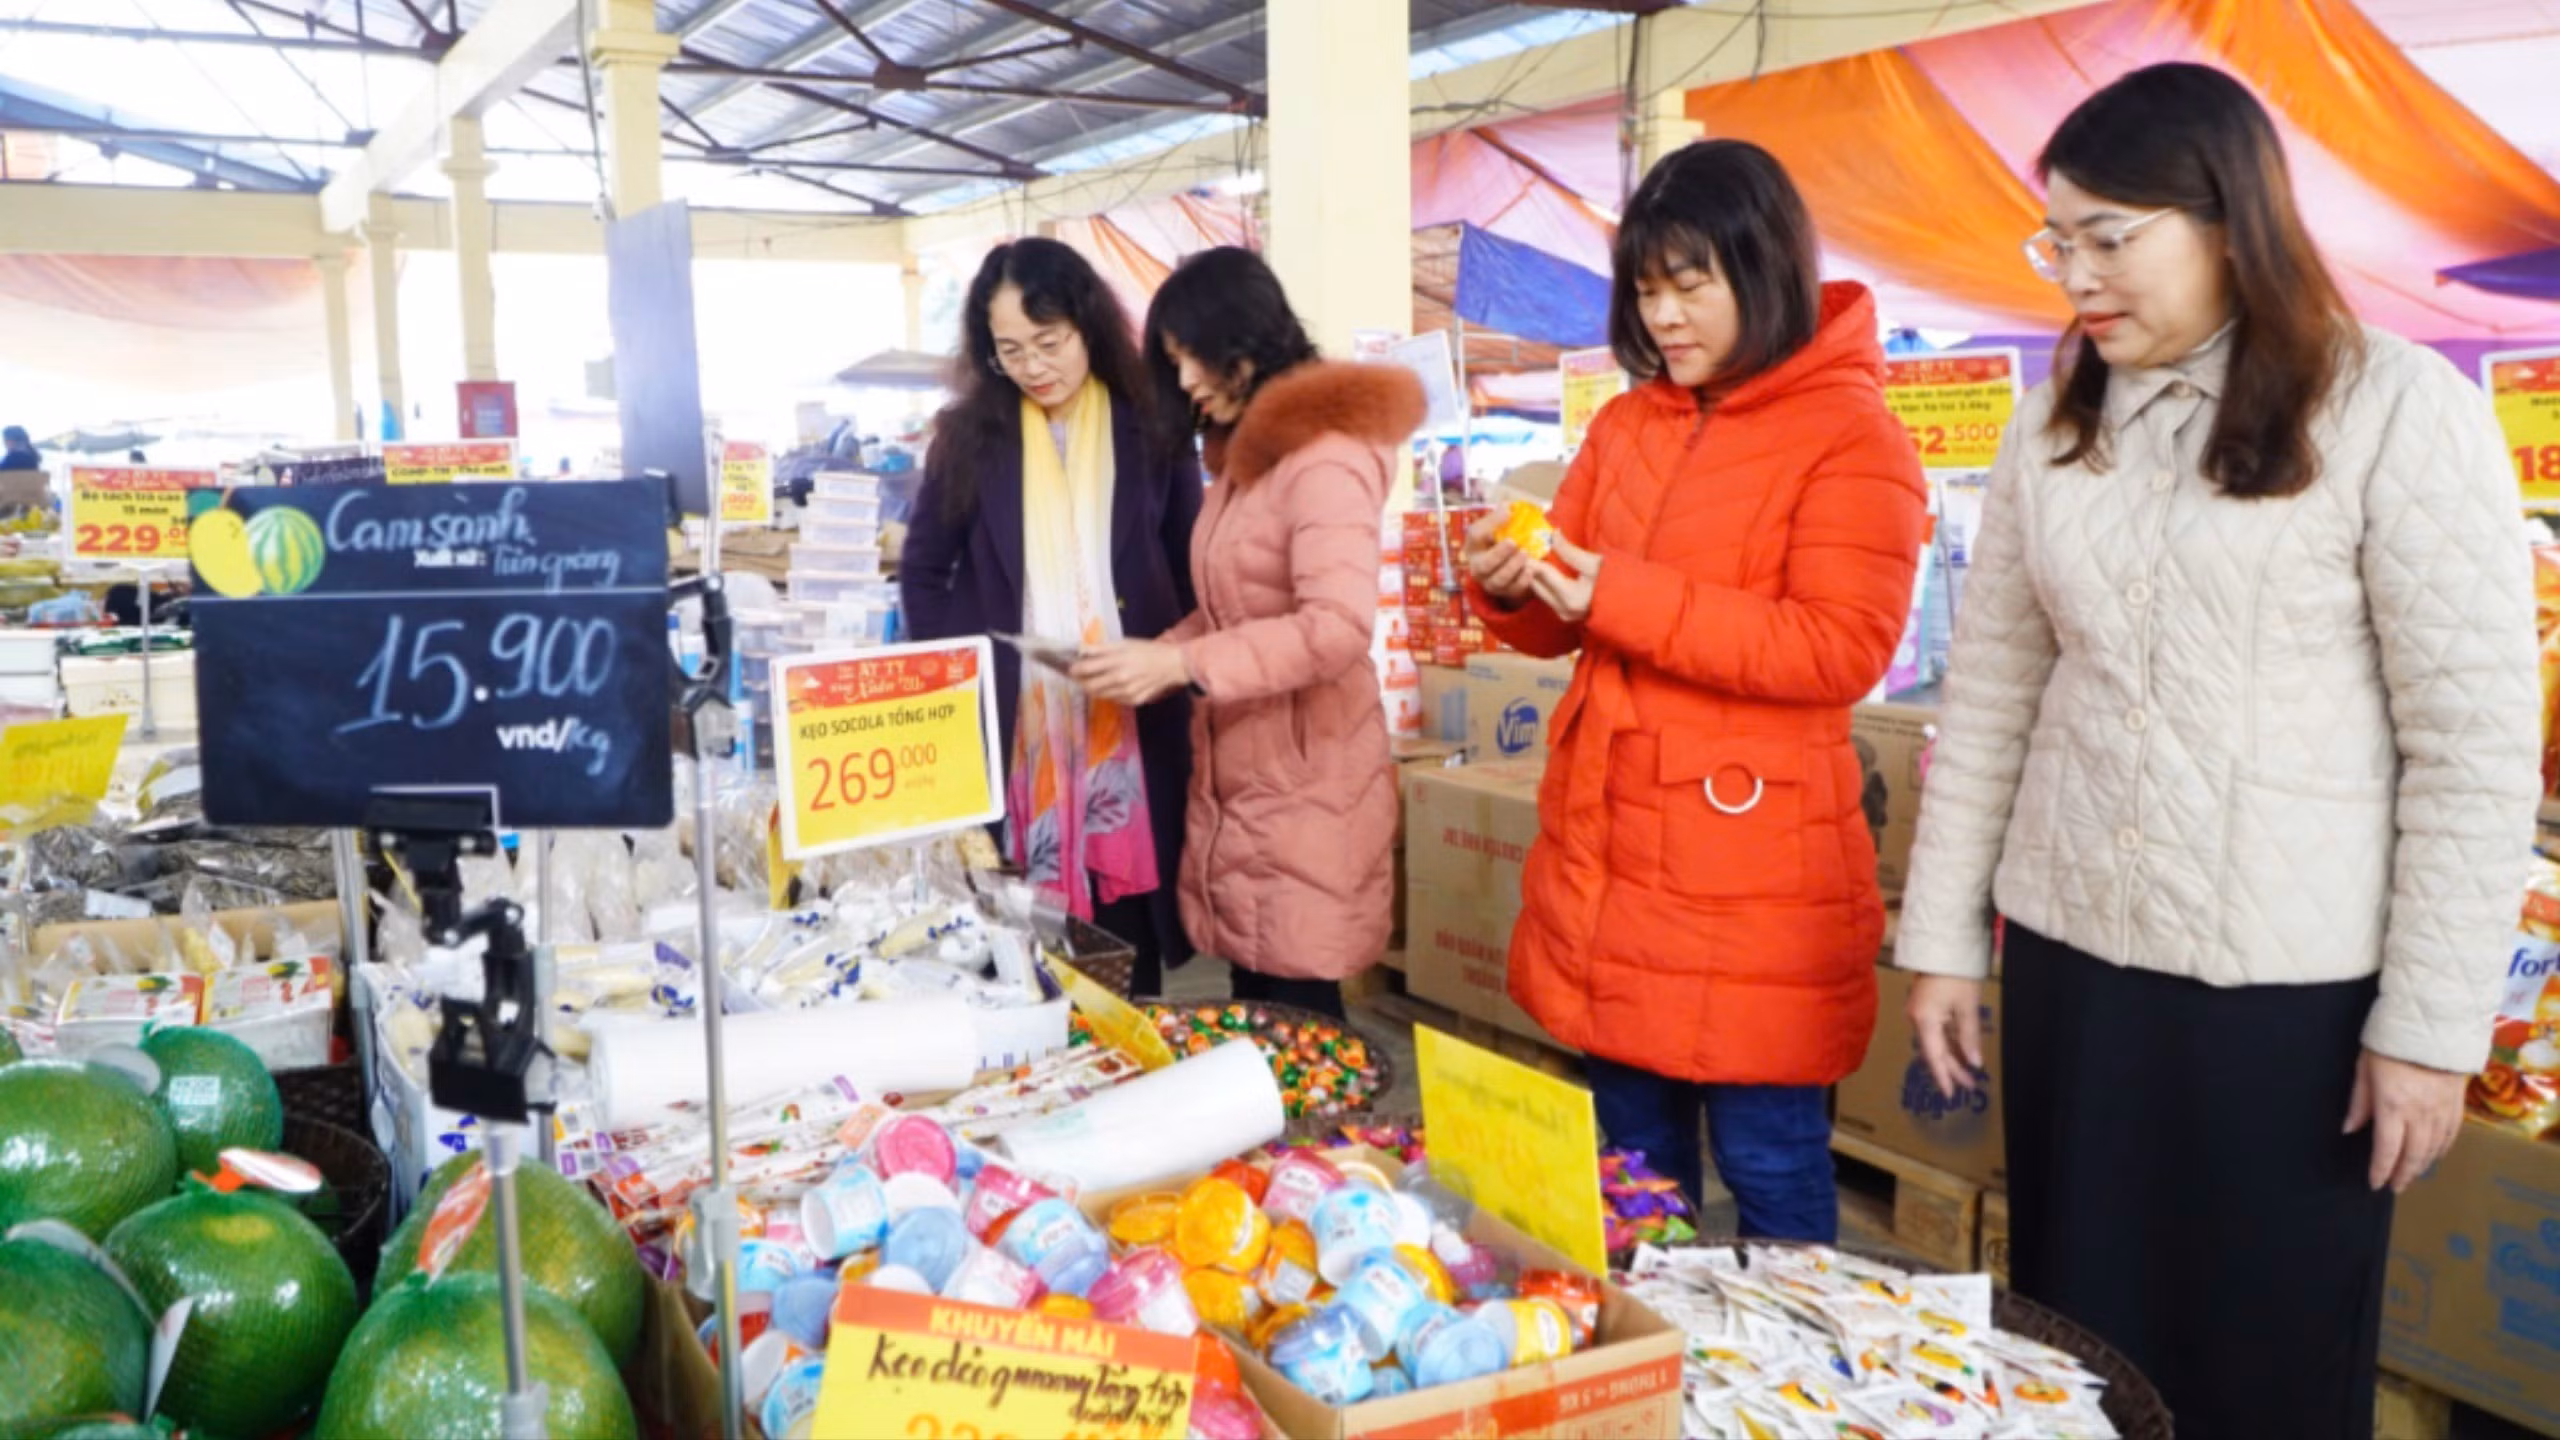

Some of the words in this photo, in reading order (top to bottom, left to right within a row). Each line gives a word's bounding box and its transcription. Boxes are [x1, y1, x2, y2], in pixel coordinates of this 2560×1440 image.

[76, 523, 160, 553] 229
[327, 489, 423, 552] Cam
[334, 612, 617, 732] 15.900
[800, 722, 828, 741] KẸO
[831, 714, 884, 736] SOCOLA
[888, 704, 924, 726] TỔNG
[1499, 708, 1536, 748] Vim
[807, 747, 896, 812] 269
[930, 1305, 1056, 1348] KHUYẾN
